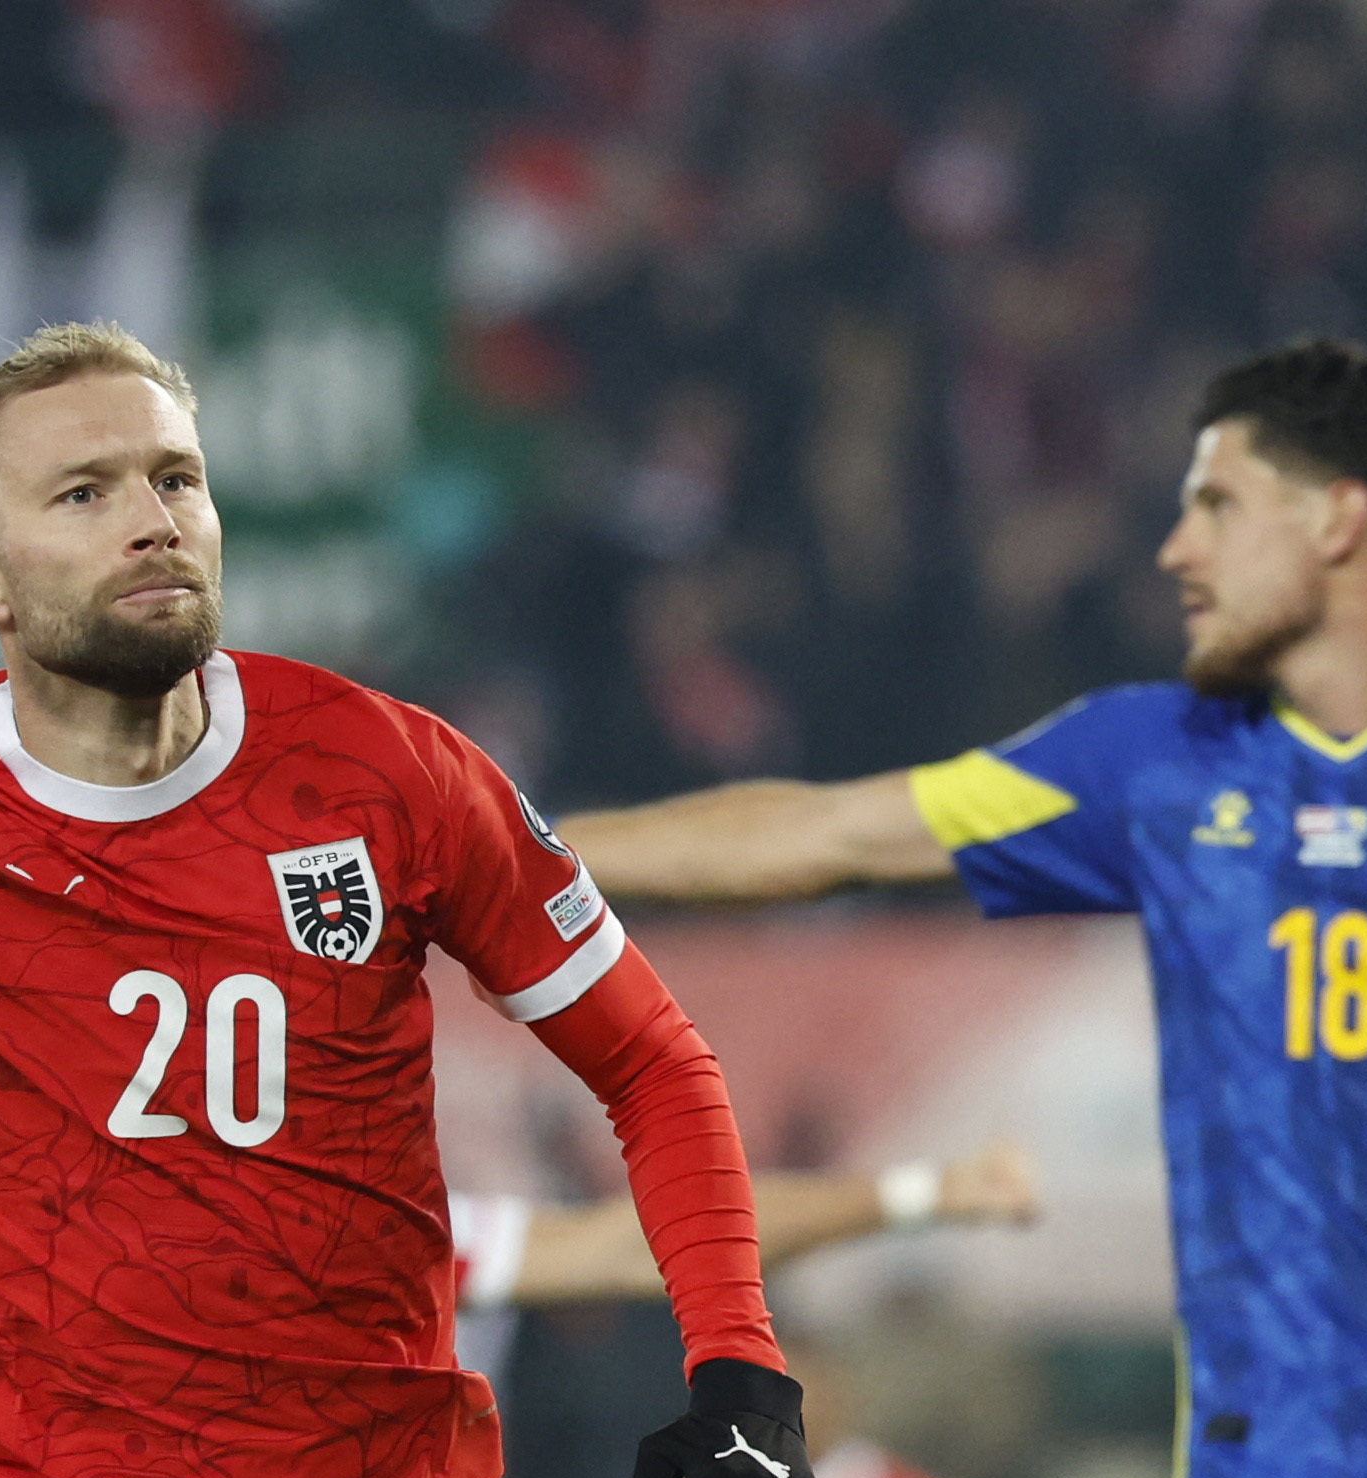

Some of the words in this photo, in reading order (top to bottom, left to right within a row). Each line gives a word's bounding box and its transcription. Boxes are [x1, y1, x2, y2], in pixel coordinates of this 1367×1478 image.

[299, 853, 338, 869] ÖFB
[549, 894, 571, 912] UEFA
[556, 885, 594, 926] FOUN
[107, 969, 287, 1148] 20
